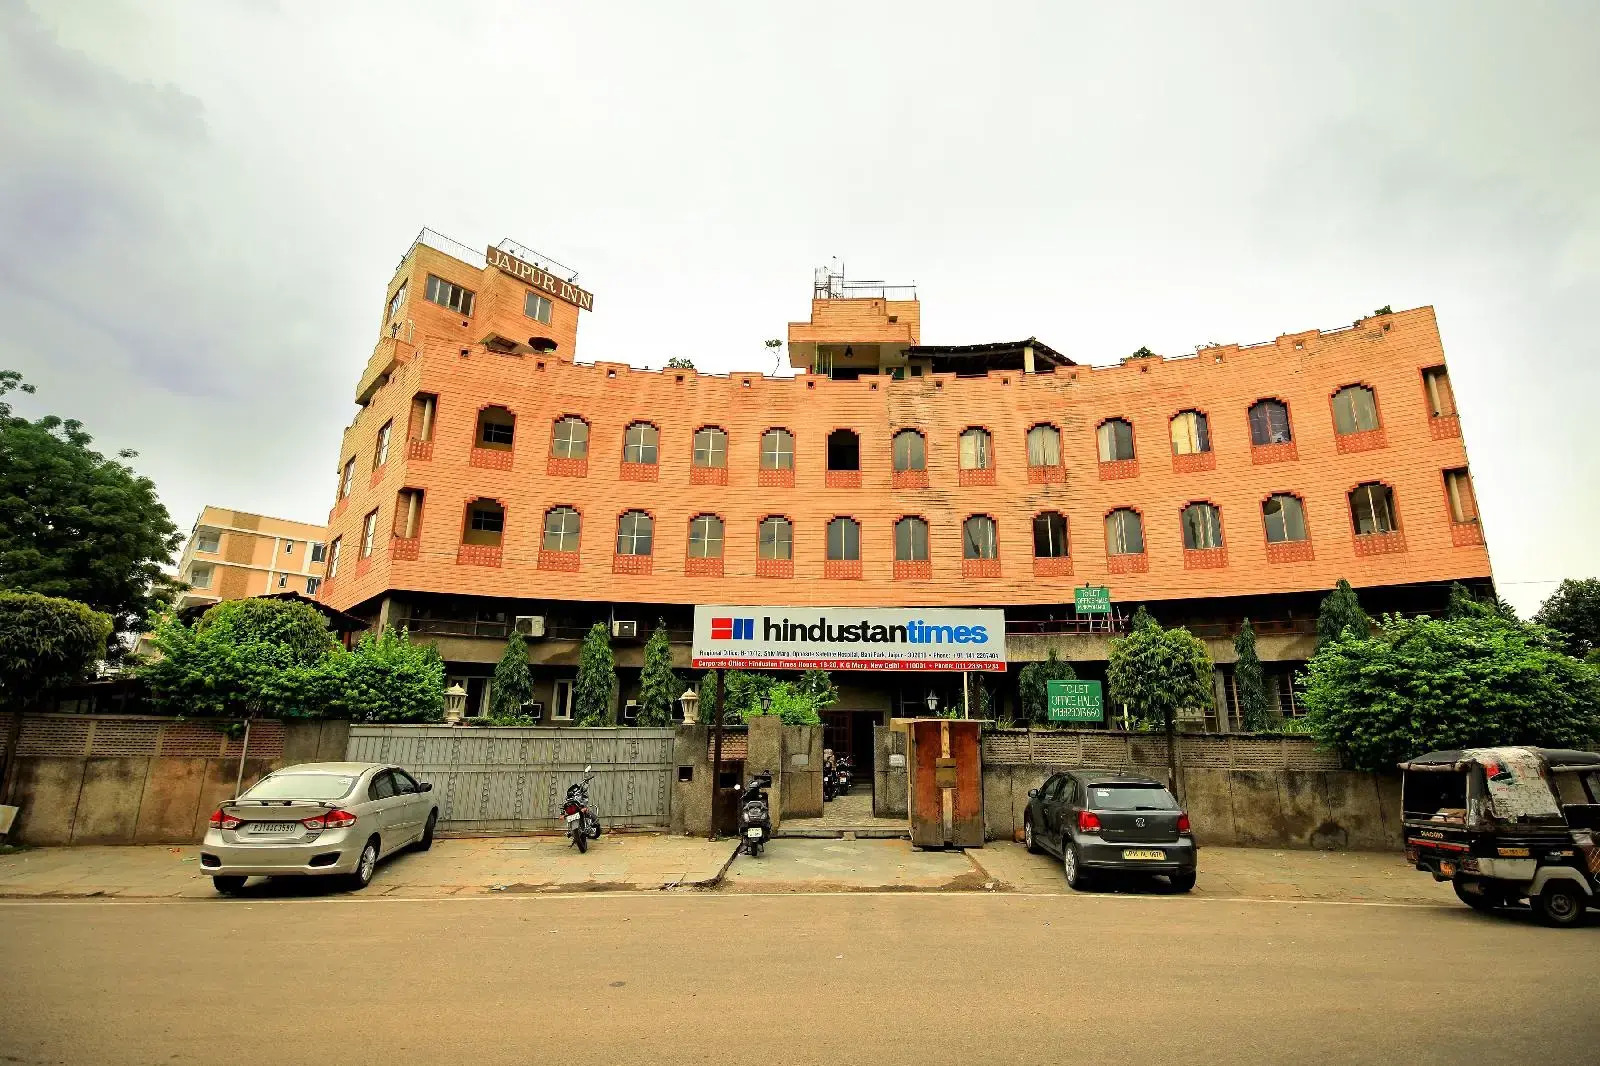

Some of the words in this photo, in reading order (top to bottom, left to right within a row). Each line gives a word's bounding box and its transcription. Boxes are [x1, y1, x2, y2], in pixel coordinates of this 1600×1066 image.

[488, 250, 557, 293] JAIPUR
[559, 281, 593, 308] INN
[763, 616, 988, 644] hindustantimes
[698, 659, 727, 668] Corporate
[748, 660, 778, 668] Hindustan
[779, 660, 797, 668] Times
